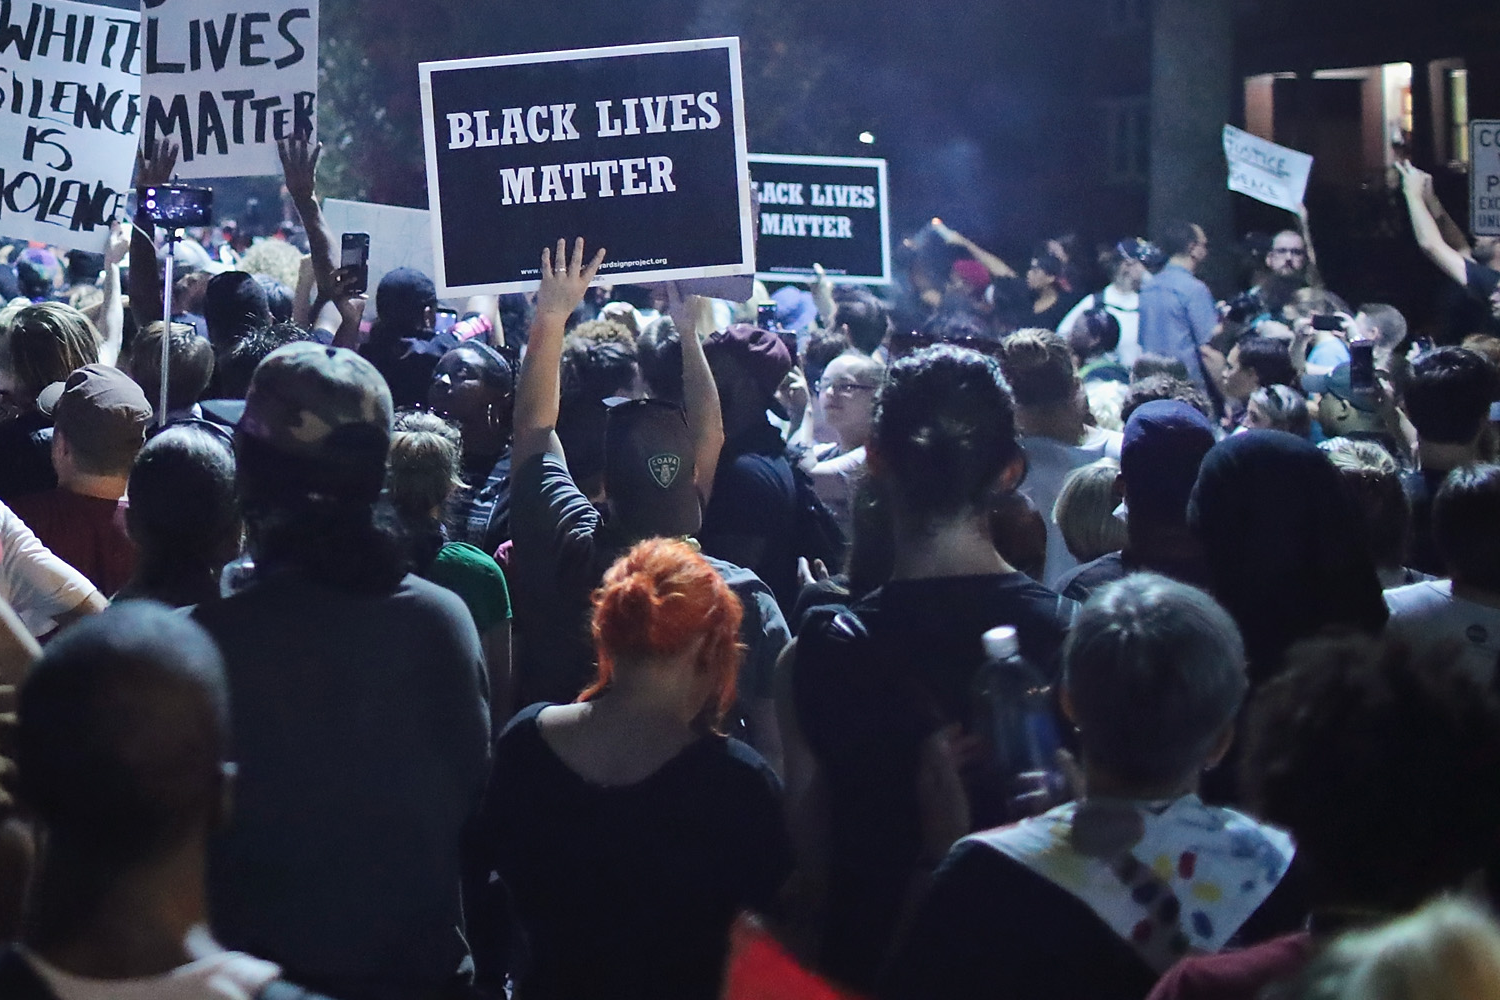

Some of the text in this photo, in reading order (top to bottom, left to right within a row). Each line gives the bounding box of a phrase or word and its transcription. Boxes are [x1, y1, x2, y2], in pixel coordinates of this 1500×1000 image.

[145, 8, 311, 75] LIVES
[144, 89, 316, 162] MATTER
[446, 91, 721, 150] BLACK LIVES
[23, 126, 73, 172] IS
[500, 155, 676, 206] MATTER
[810, 184, 876, 209] LIVES
[761, 213, 852, 238] MATTER
